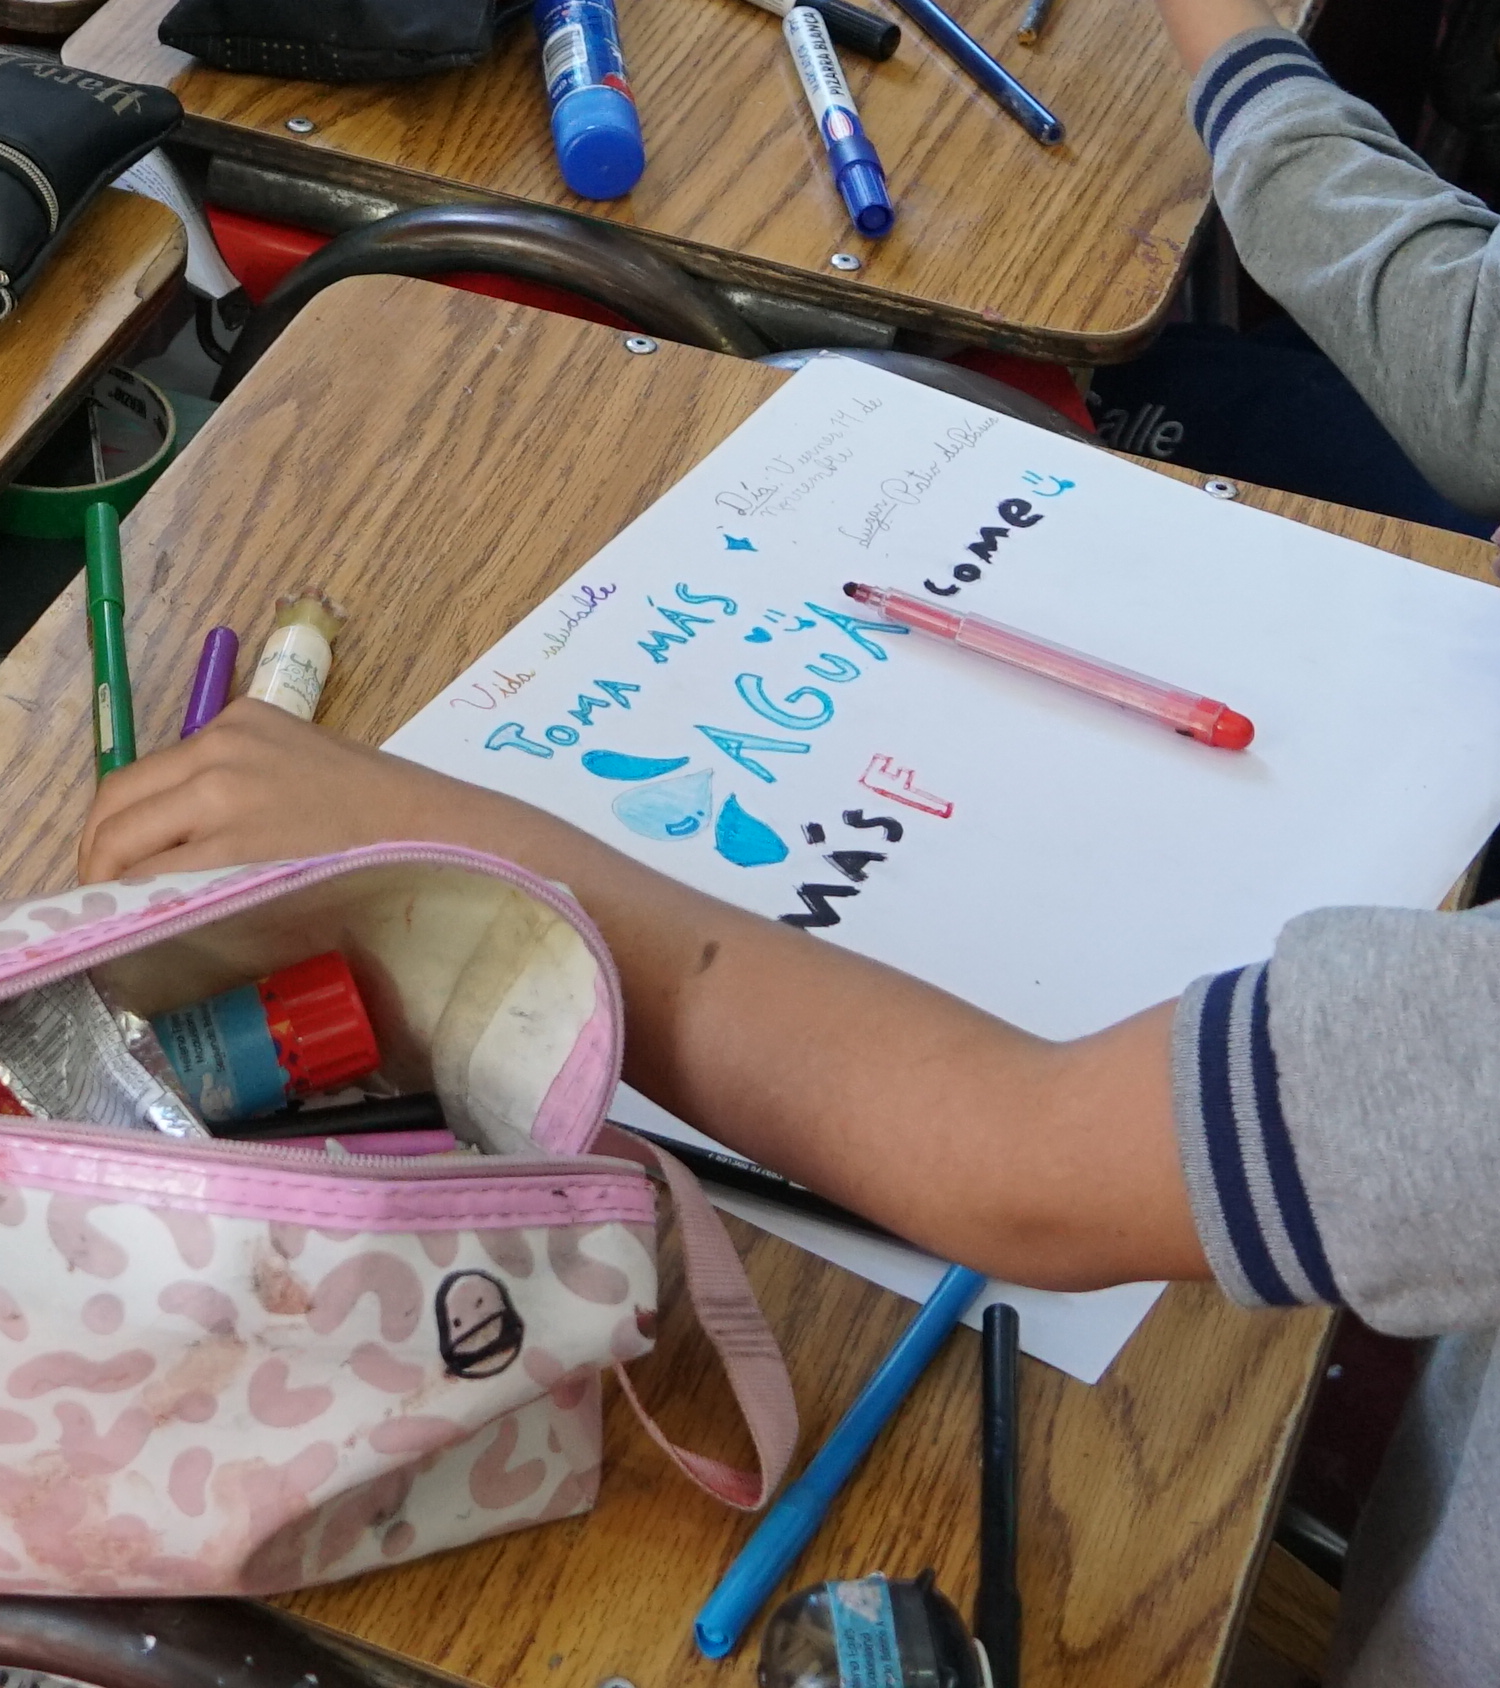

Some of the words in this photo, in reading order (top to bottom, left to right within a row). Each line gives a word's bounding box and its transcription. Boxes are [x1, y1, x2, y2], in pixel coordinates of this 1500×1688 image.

[16, 61, 148, 116] Harry
[801, 11, 829, 52] BLANCA
[818, 51, 847, 96] PIZARRA
[1084, 390, 1185, 457] alle
[450, 669, 536, 711] Vida
[484, 678, 642, 760] TOMA
[637, 581, 739, 665] MÁS
[693, 600, 912, 785] AGUA
[776, 807, 905, 932] MÁS
